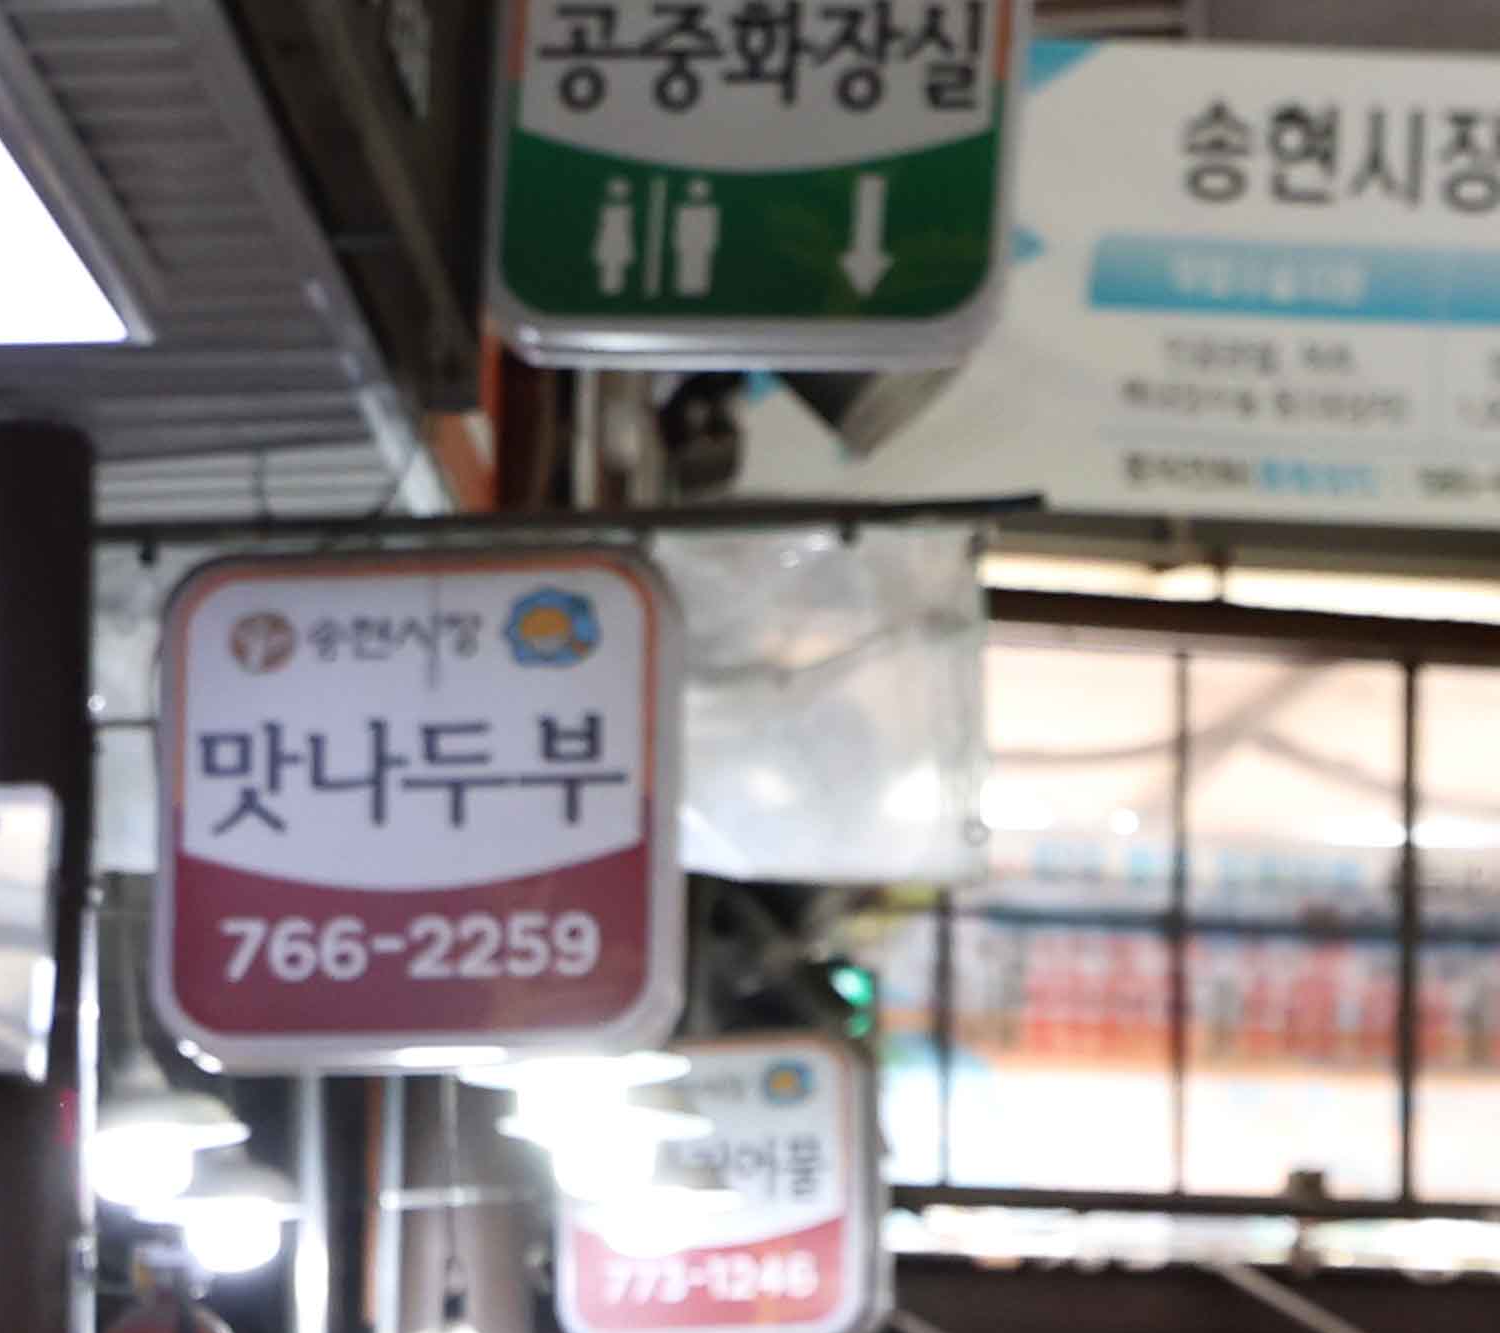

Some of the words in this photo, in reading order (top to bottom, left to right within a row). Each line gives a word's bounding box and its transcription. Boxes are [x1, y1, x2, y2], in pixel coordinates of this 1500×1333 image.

[535, 0, 984, 113] 공중화장실
[1180, 94, 1500, 213] 송현시장
[305, 610, 484, 690] 송현시장
[198, 712, 629, 837] 맛나두부
[217, 912, 601, 983] 766-2259
